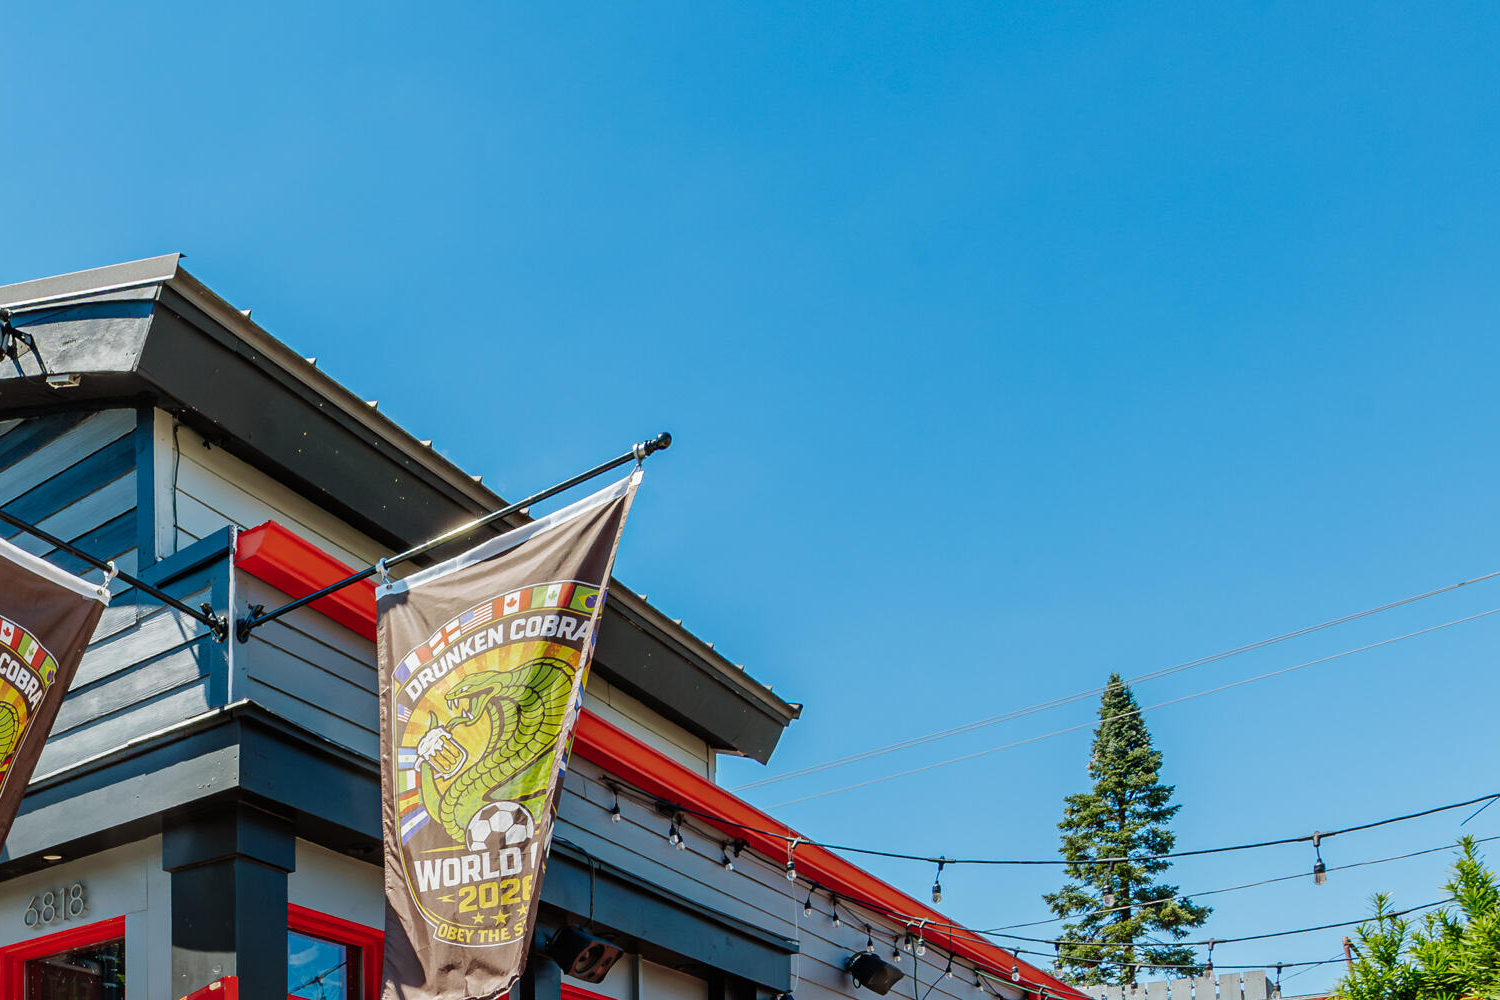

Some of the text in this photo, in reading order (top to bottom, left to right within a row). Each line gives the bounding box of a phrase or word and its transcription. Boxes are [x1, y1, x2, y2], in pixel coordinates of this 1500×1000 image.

[404, 614, 593, 702] DRUNKEN COBRA
[414, 846, 522, 893] WORLD
[24, 883, 87, 930] 6818
[437, 923, 474, 943] OBEY
[478, 926, 511, 943] THE
